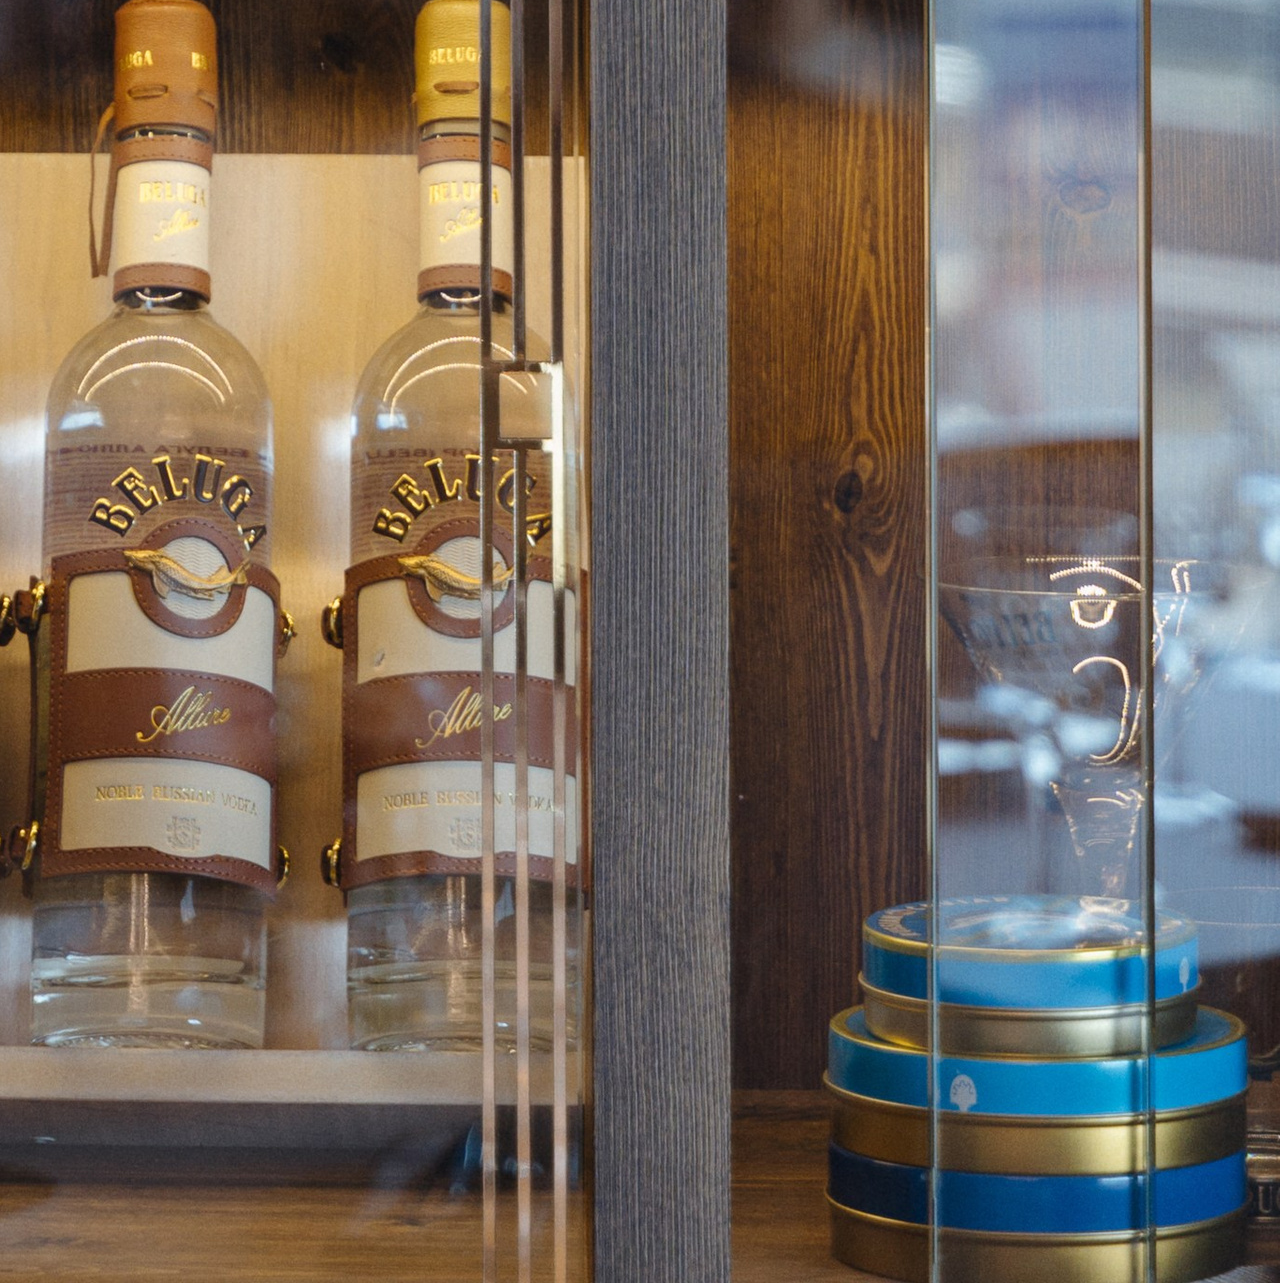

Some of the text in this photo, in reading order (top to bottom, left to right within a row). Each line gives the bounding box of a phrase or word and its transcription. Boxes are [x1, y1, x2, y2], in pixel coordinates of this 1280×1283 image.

[429, 46, 482, 65] BELUG
[88, 453, 268, 552] BELUGA
[136, 685, 231, 742] Allure
[95, 786, 258, 815] NOBLE RUSSIAN VODKA
[382, 792, 429, 812] NOBLE
[436, 790, 503, 806] RUSSIN
